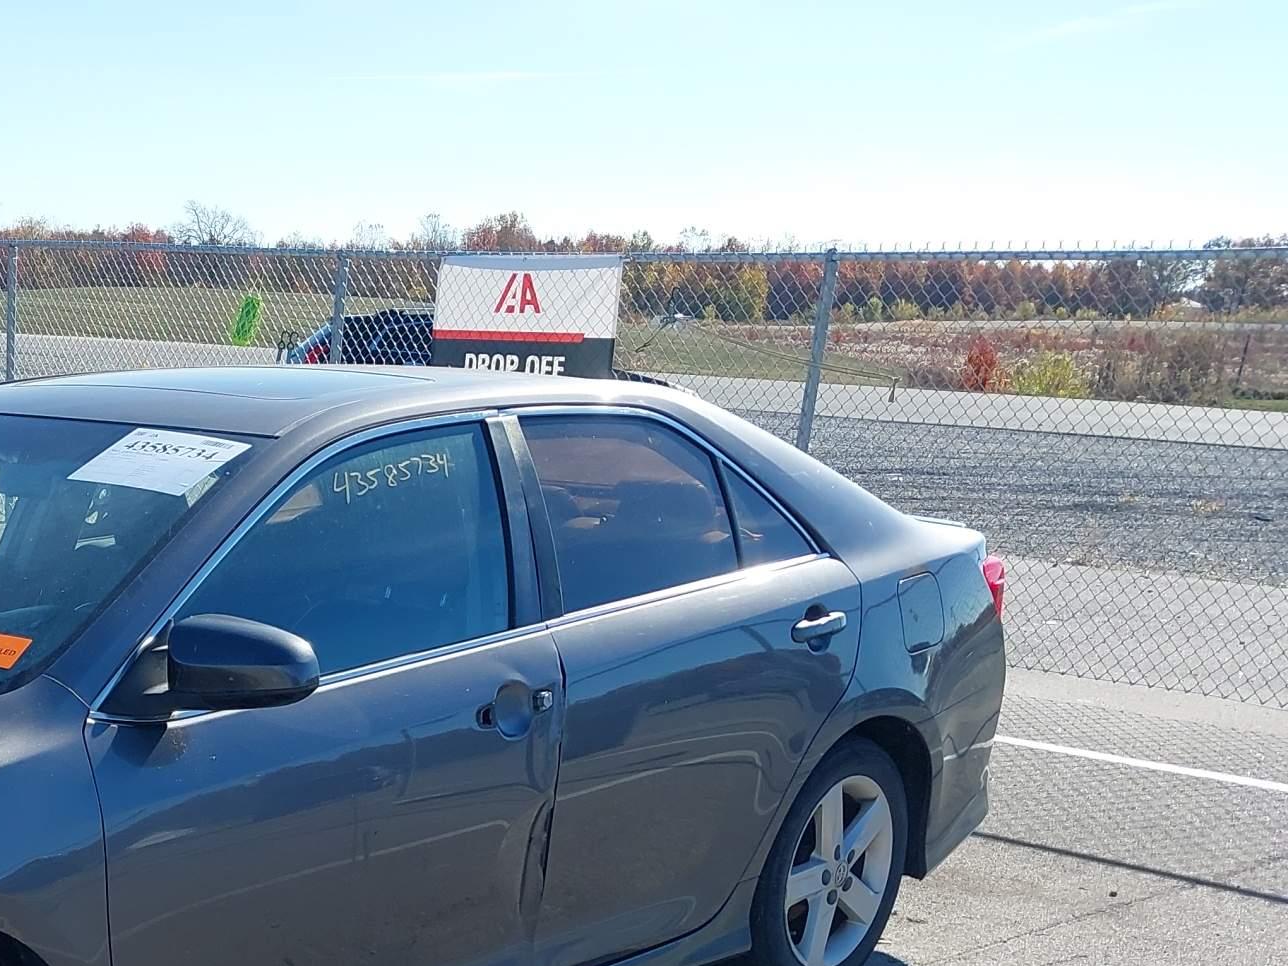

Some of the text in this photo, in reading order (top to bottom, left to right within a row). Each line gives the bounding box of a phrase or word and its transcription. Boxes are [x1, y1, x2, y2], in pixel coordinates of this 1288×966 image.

[464, 353, 566, 376] DROP OFF
[124, 440, 219, 461] 43585734
[333, 453, 449, 504] 43585734
